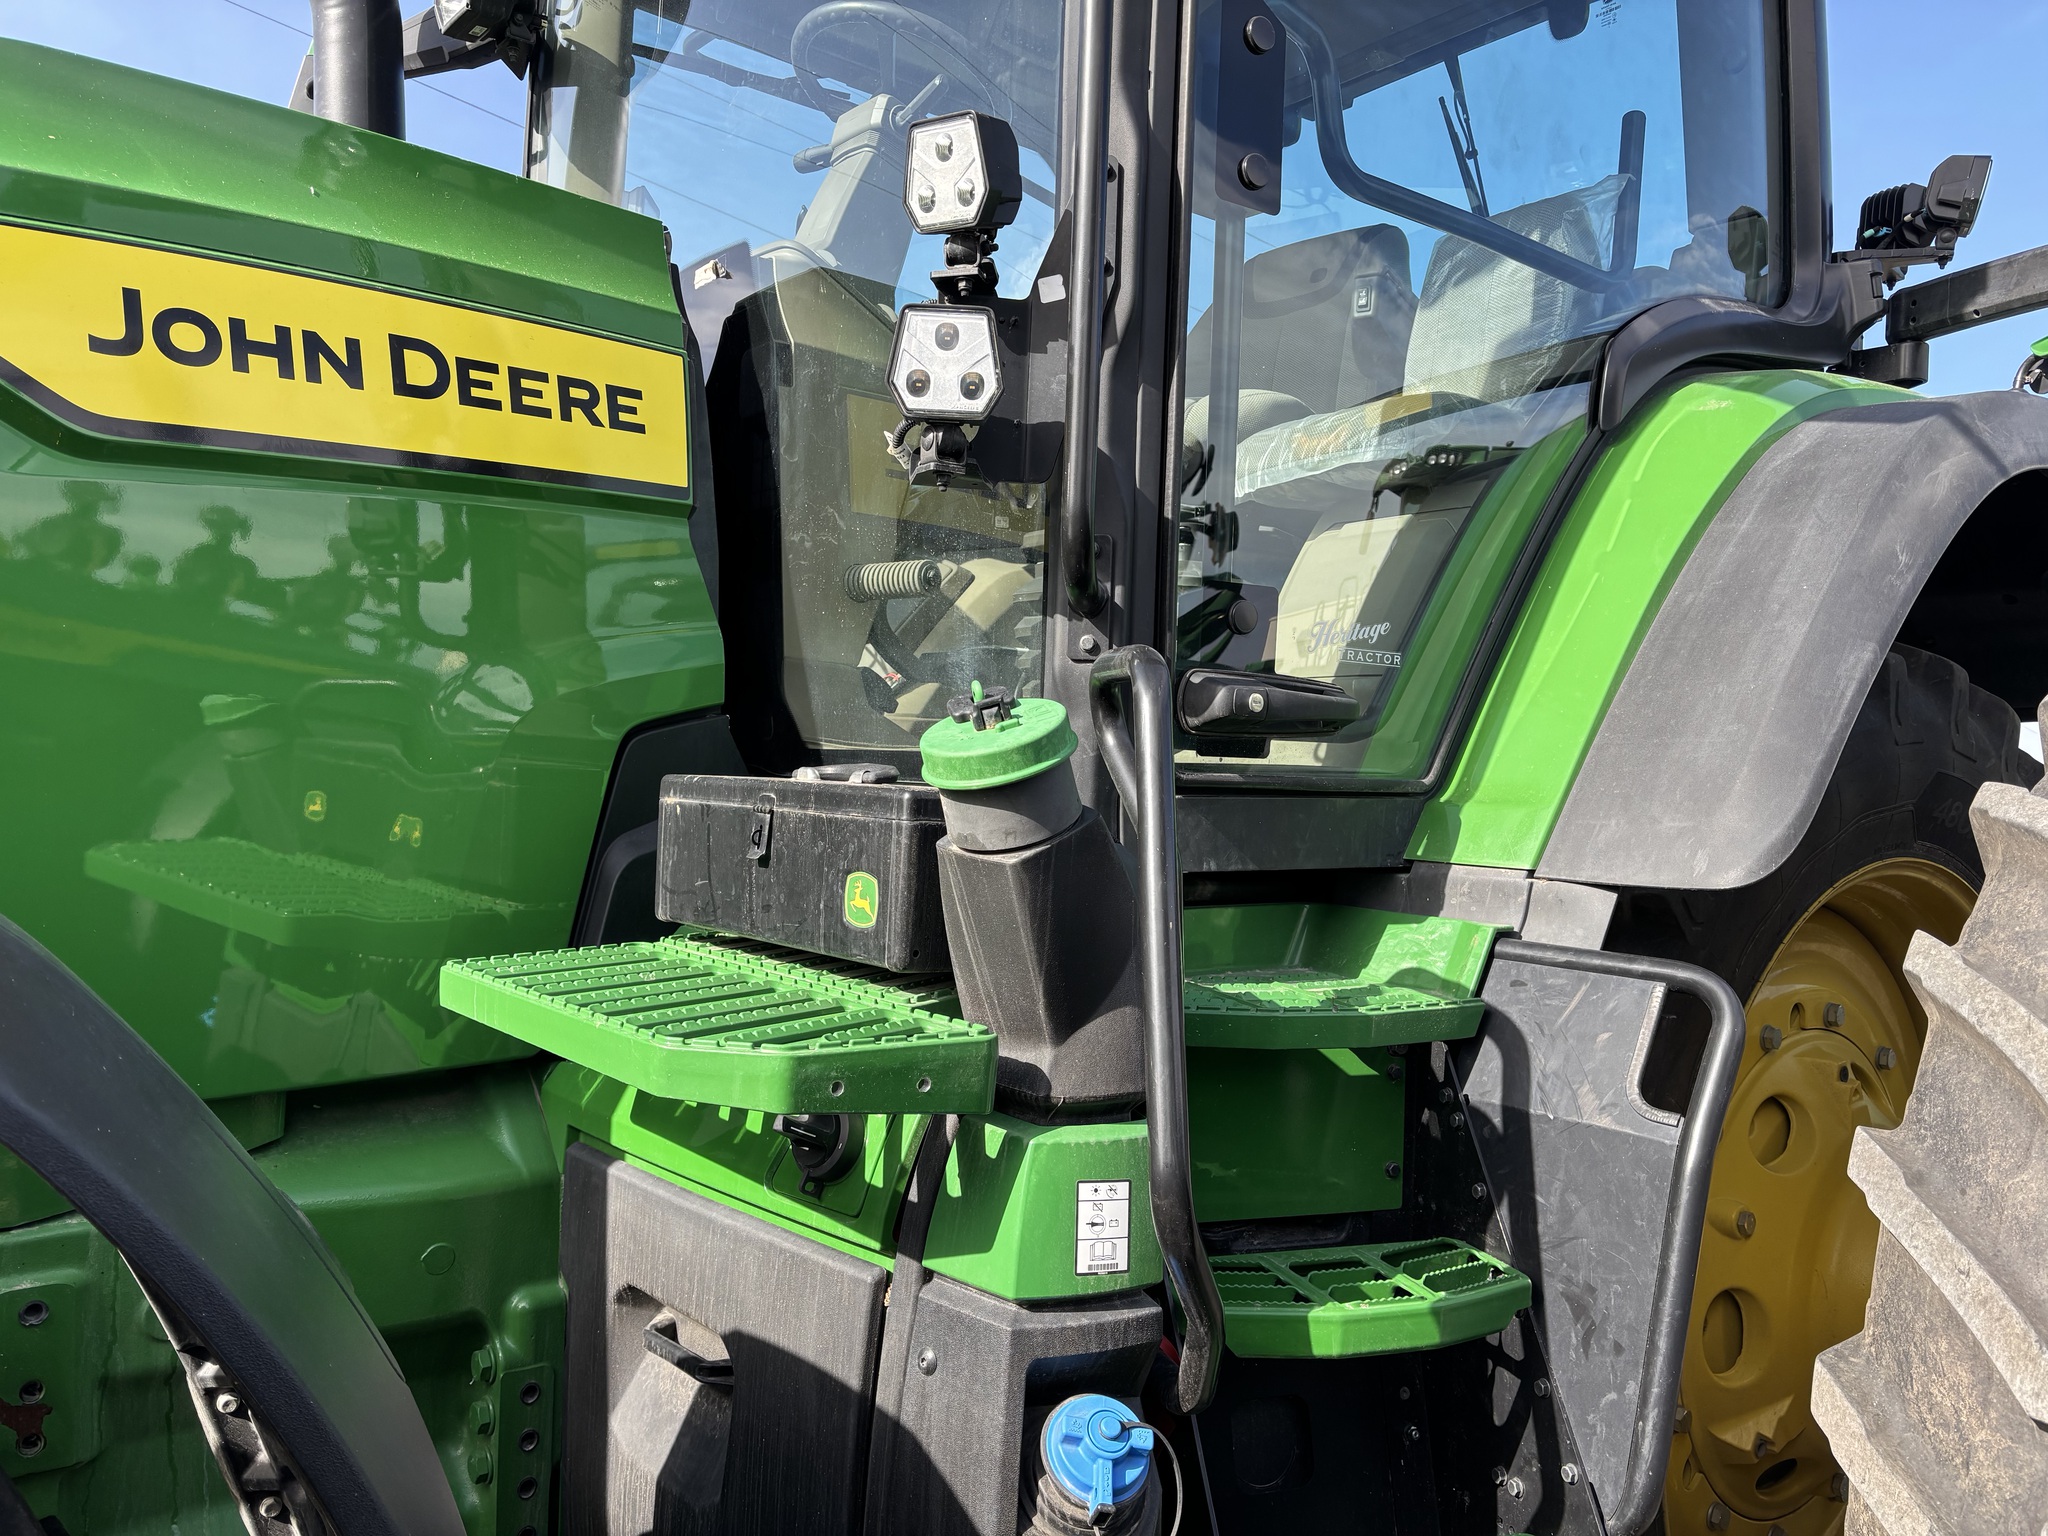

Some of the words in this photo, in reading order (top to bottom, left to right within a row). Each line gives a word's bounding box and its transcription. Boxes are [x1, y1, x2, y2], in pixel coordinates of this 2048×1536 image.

[88, 286, 365, 391] JOHN
[387, 333, 646, 435] DEERE
[1307, 618, 1392, 653] Heritage
[1339, 649, 1401, 665] TRACTOR
